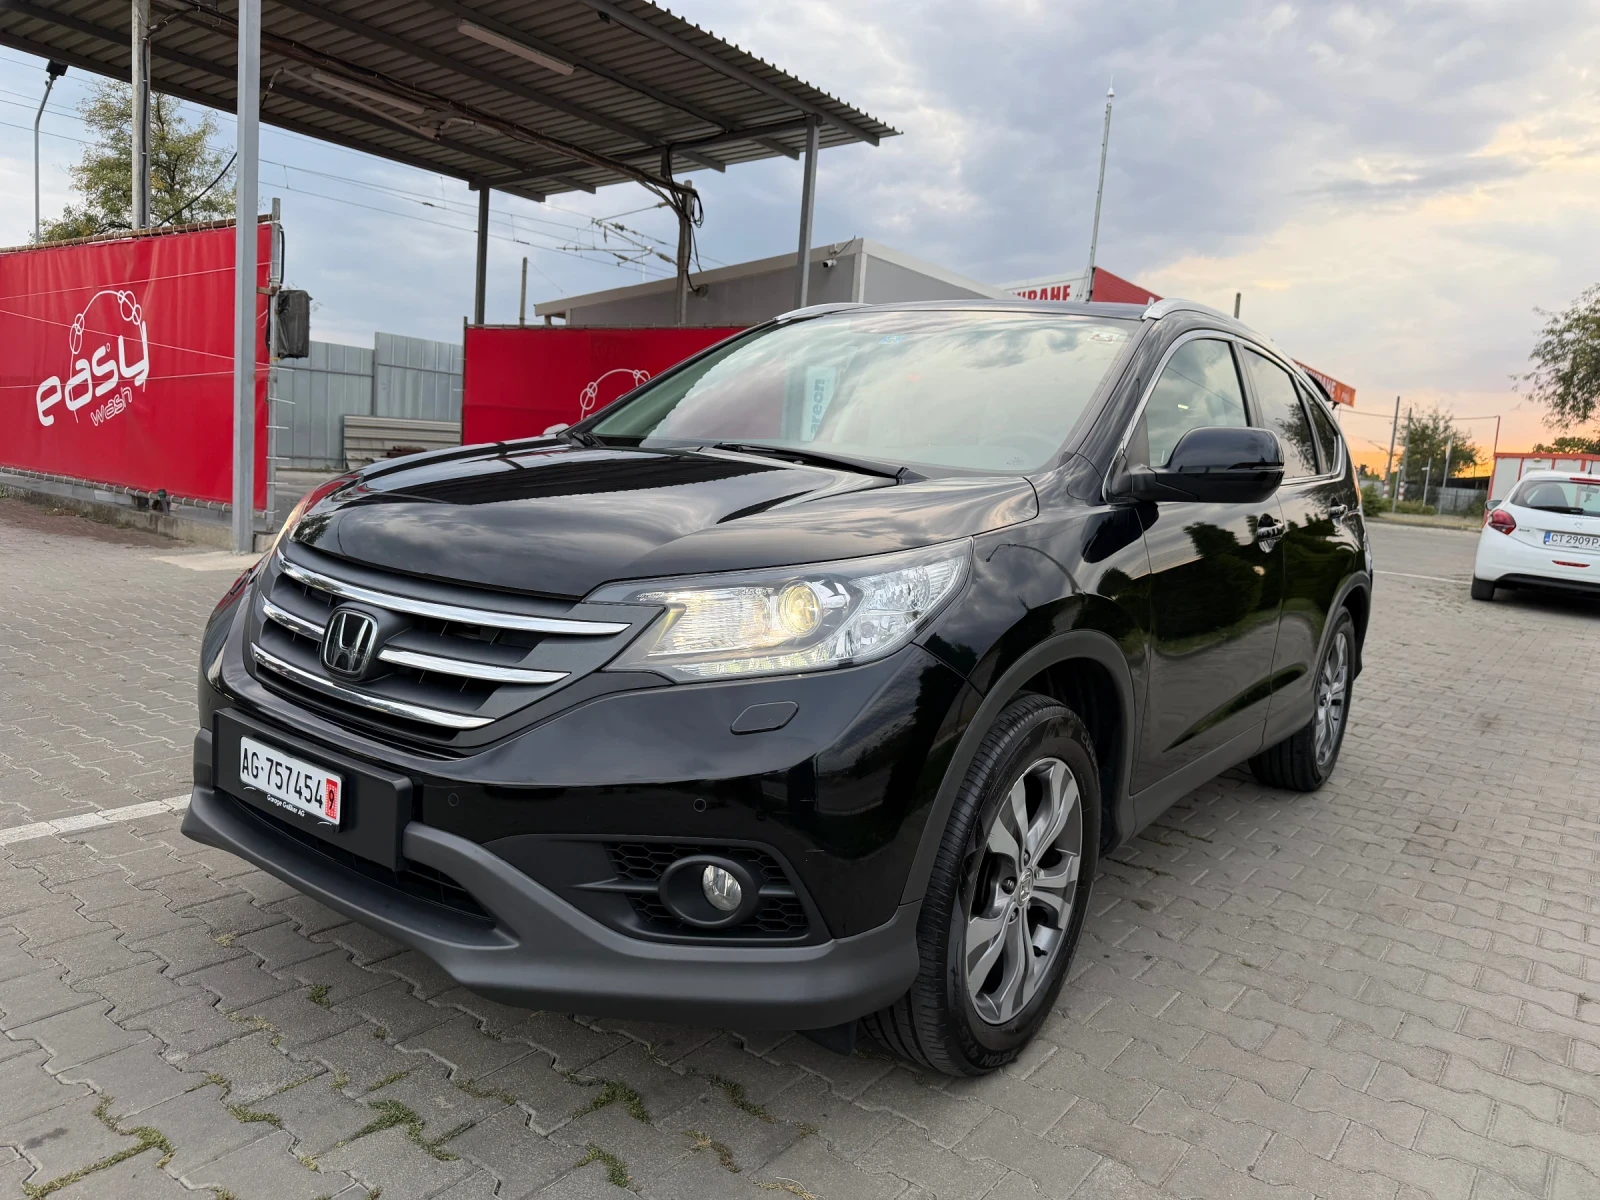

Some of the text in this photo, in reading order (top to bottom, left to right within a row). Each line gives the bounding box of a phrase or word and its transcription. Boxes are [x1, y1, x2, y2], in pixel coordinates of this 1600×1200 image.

[36, 320, 150, 427] easy
[90, 386, 133, 427] wash
[1551, 534, 1565, 543] CT
[1566, 535, 1591, 546] 2909
